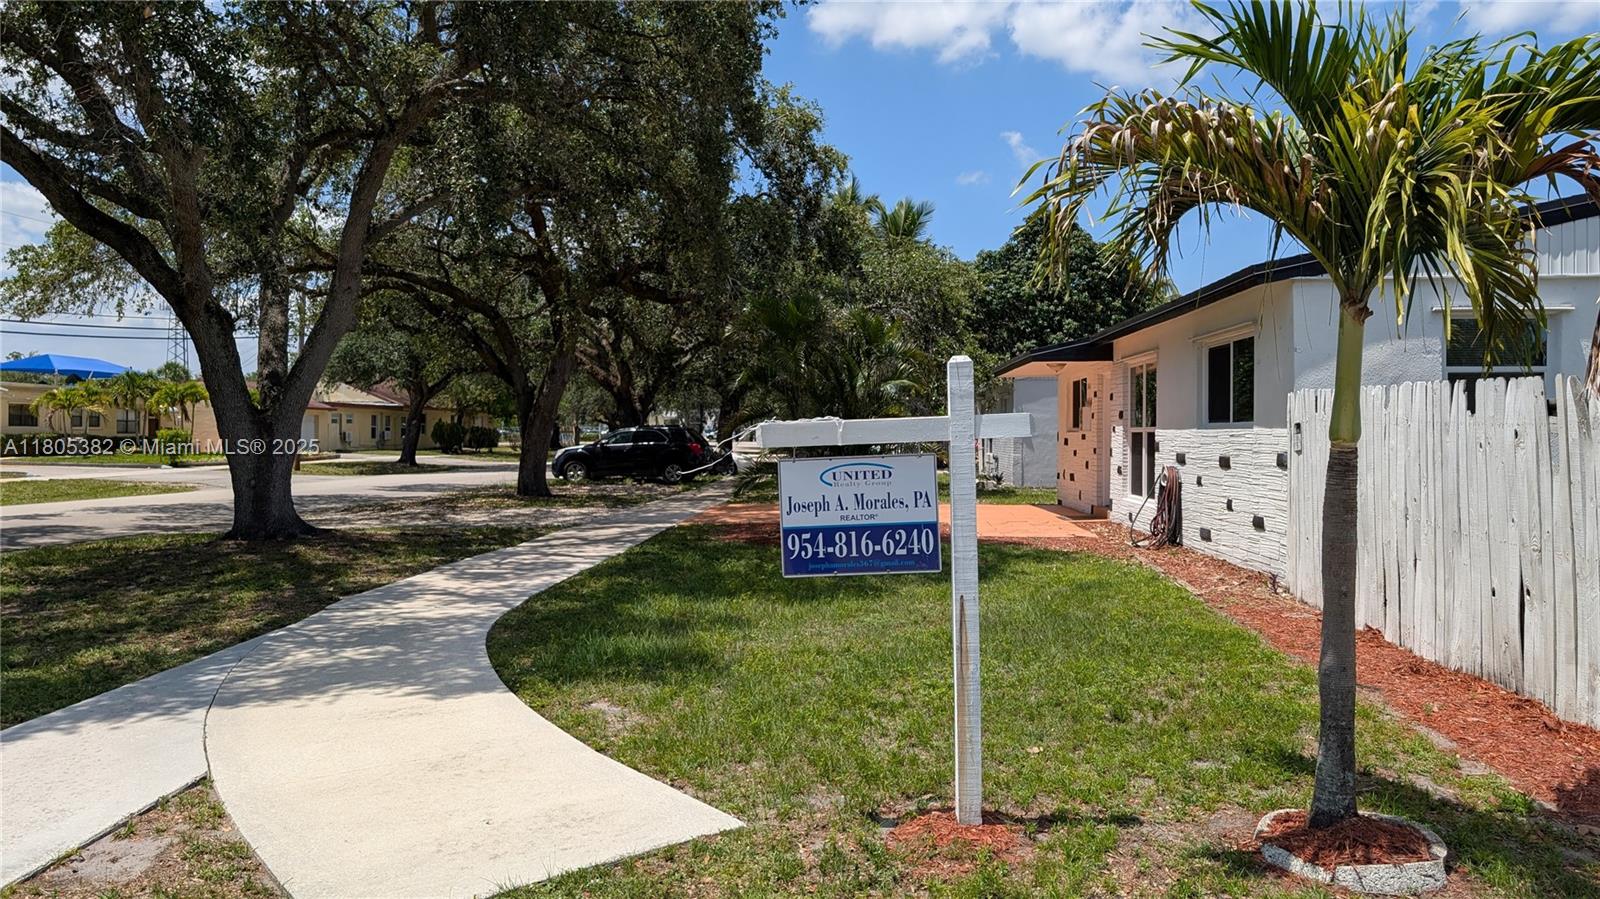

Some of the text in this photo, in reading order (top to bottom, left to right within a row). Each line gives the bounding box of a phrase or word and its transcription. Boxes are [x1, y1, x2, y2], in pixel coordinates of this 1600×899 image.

[832, 470, 892, 481] UNITED
[786, 490, 932, 517] Joseph A. Morales, PA
[787, 528, 934, 560] 954-816-6240
